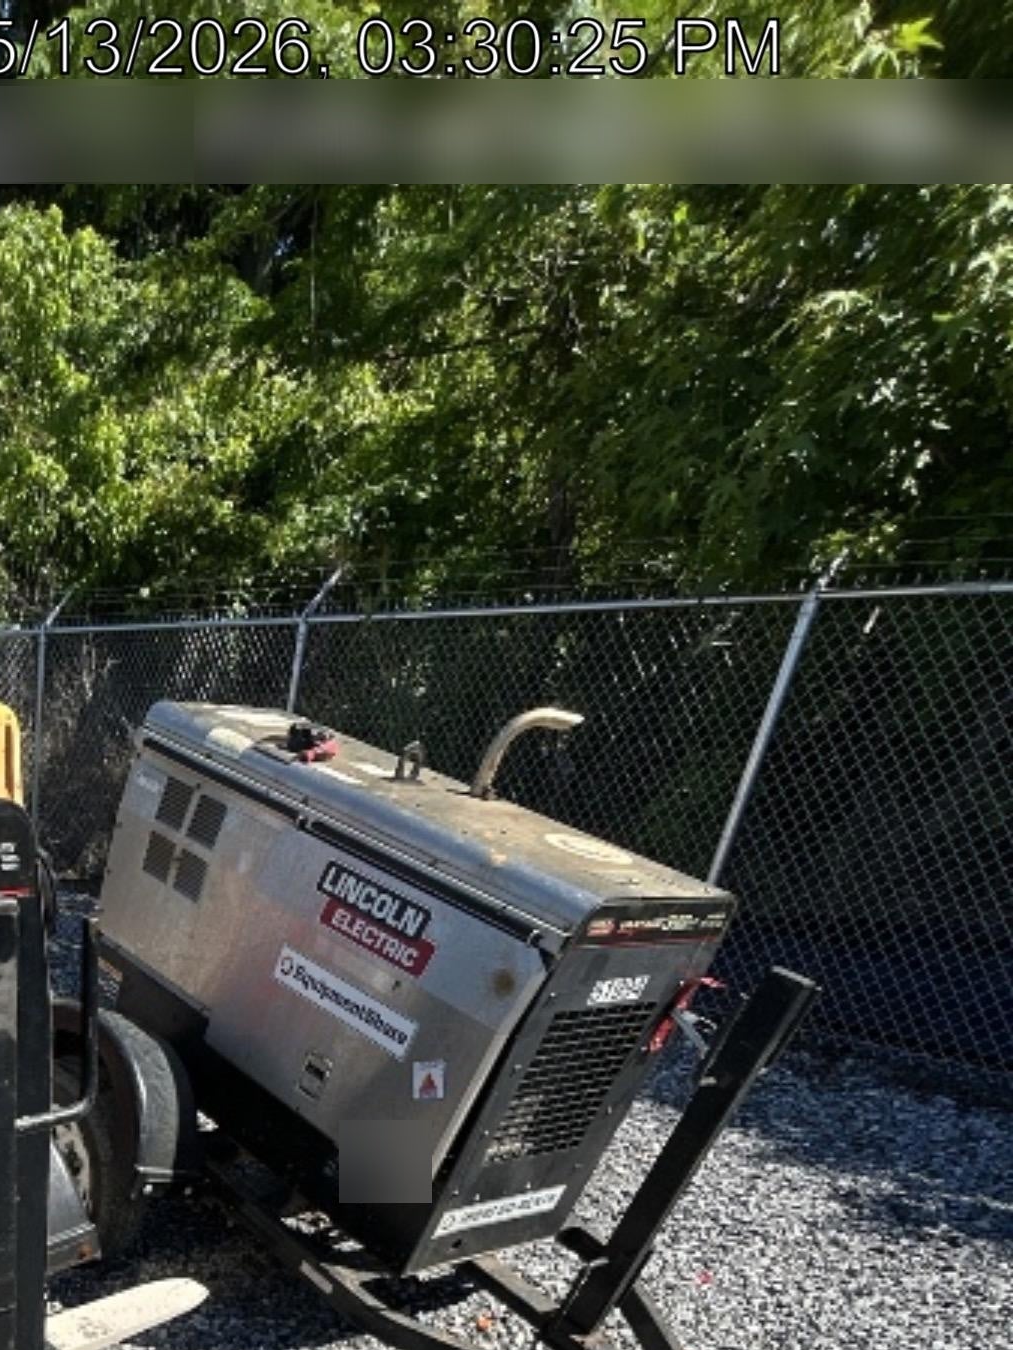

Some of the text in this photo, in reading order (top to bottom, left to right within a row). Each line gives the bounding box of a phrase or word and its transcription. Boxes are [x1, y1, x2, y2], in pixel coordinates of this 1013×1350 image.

[322, 866, 424, 938] LINCOLN
[331, 907, 419, 968] ELECTRIC
[292, 964, 409, 1046] EquipmentShare
